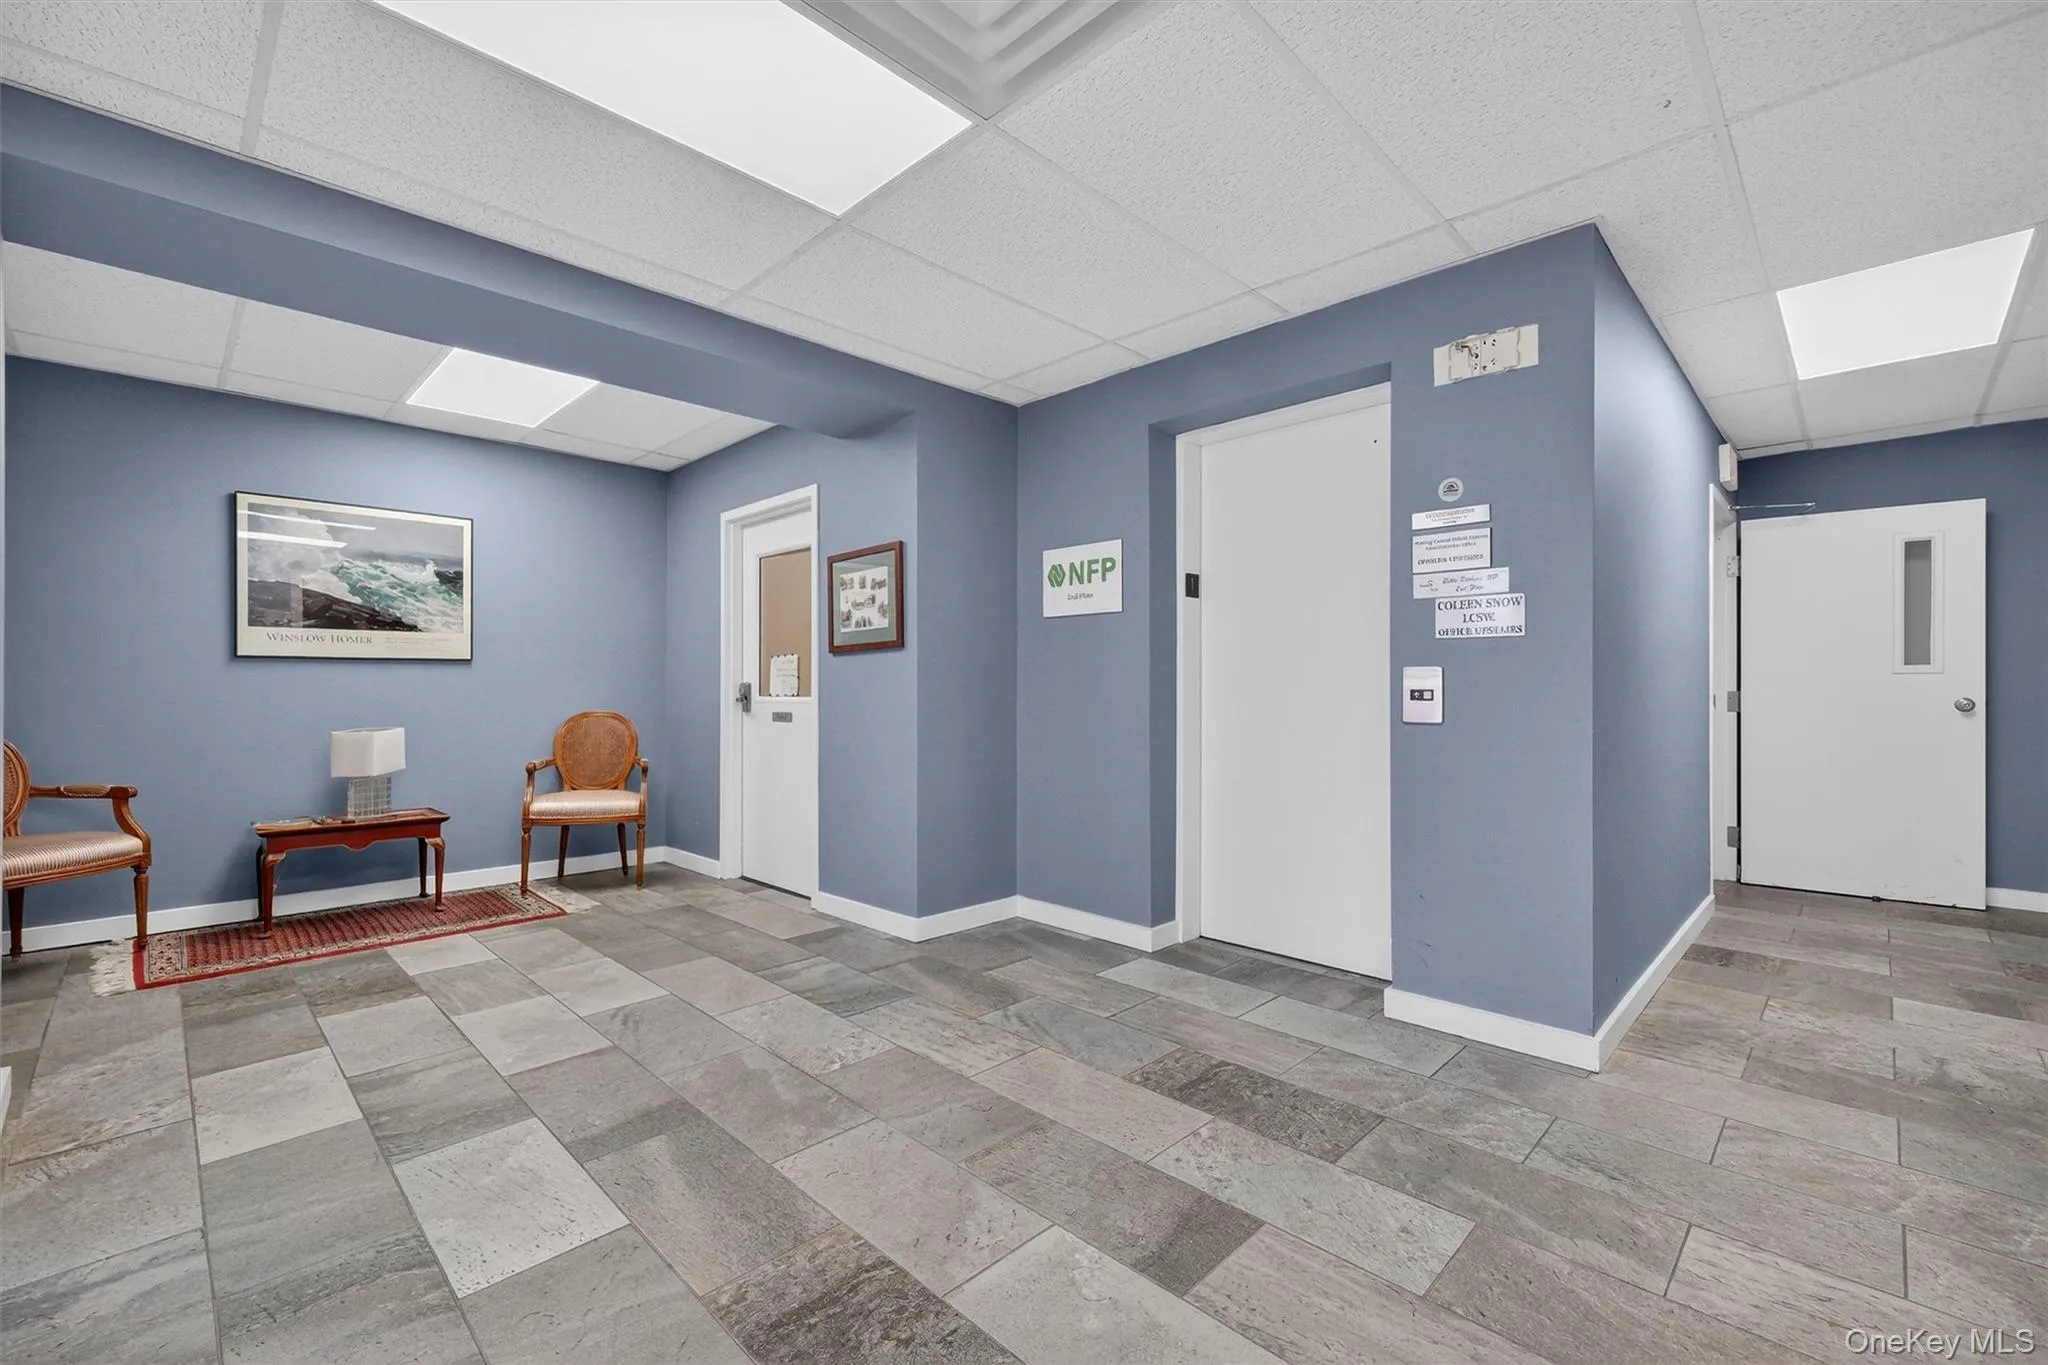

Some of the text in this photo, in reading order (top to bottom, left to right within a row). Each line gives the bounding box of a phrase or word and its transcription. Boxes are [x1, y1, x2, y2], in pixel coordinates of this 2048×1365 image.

[1069, 557, 1117, 586] NFP
[1437, 596, 1523, 611] COLEEN SNOW
[266, 632, 326, 643] WINSLOW
[331, 634, 373, 645] HOMER
